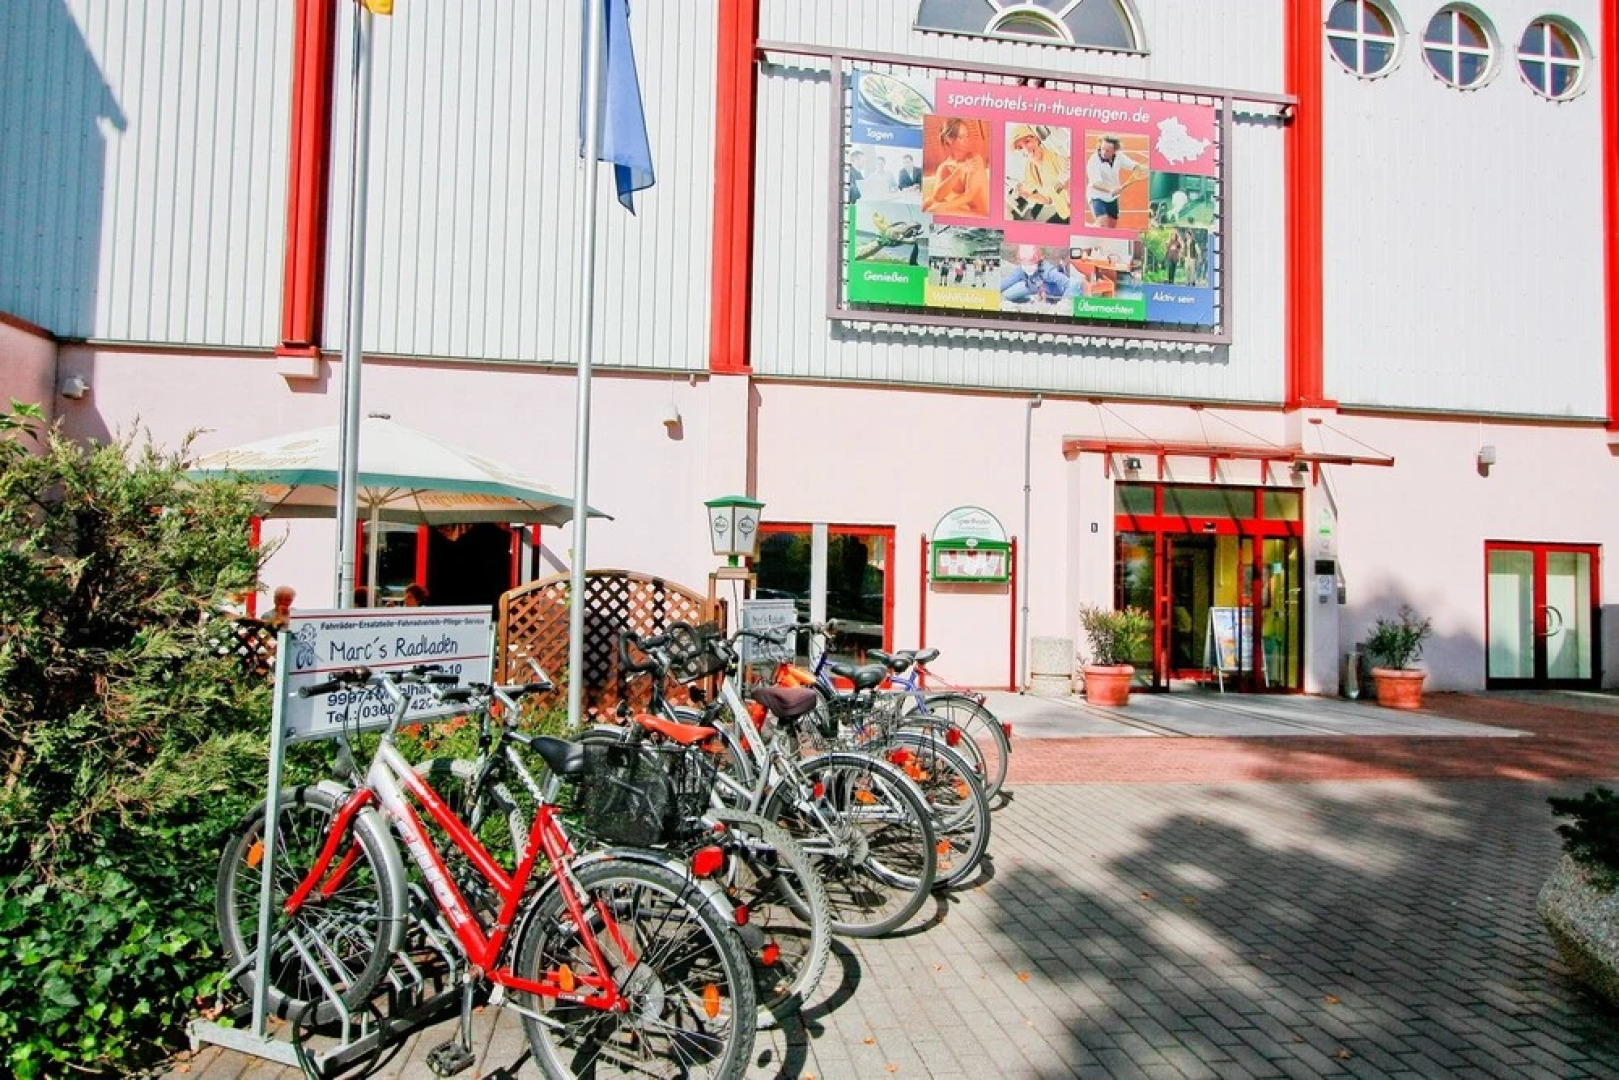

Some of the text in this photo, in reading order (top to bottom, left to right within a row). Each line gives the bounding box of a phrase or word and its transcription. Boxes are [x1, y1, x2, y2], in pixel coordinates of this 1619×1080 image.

[946, 93, 1150, 124] sporthotels-in-thueringen.de
[866, 127, 894, 141] Tagen
[863, 270, 909, 284] Genießen
[1077, 301, 1135, 316] Übernachten
[395, 633, 459, 658] Radladen
